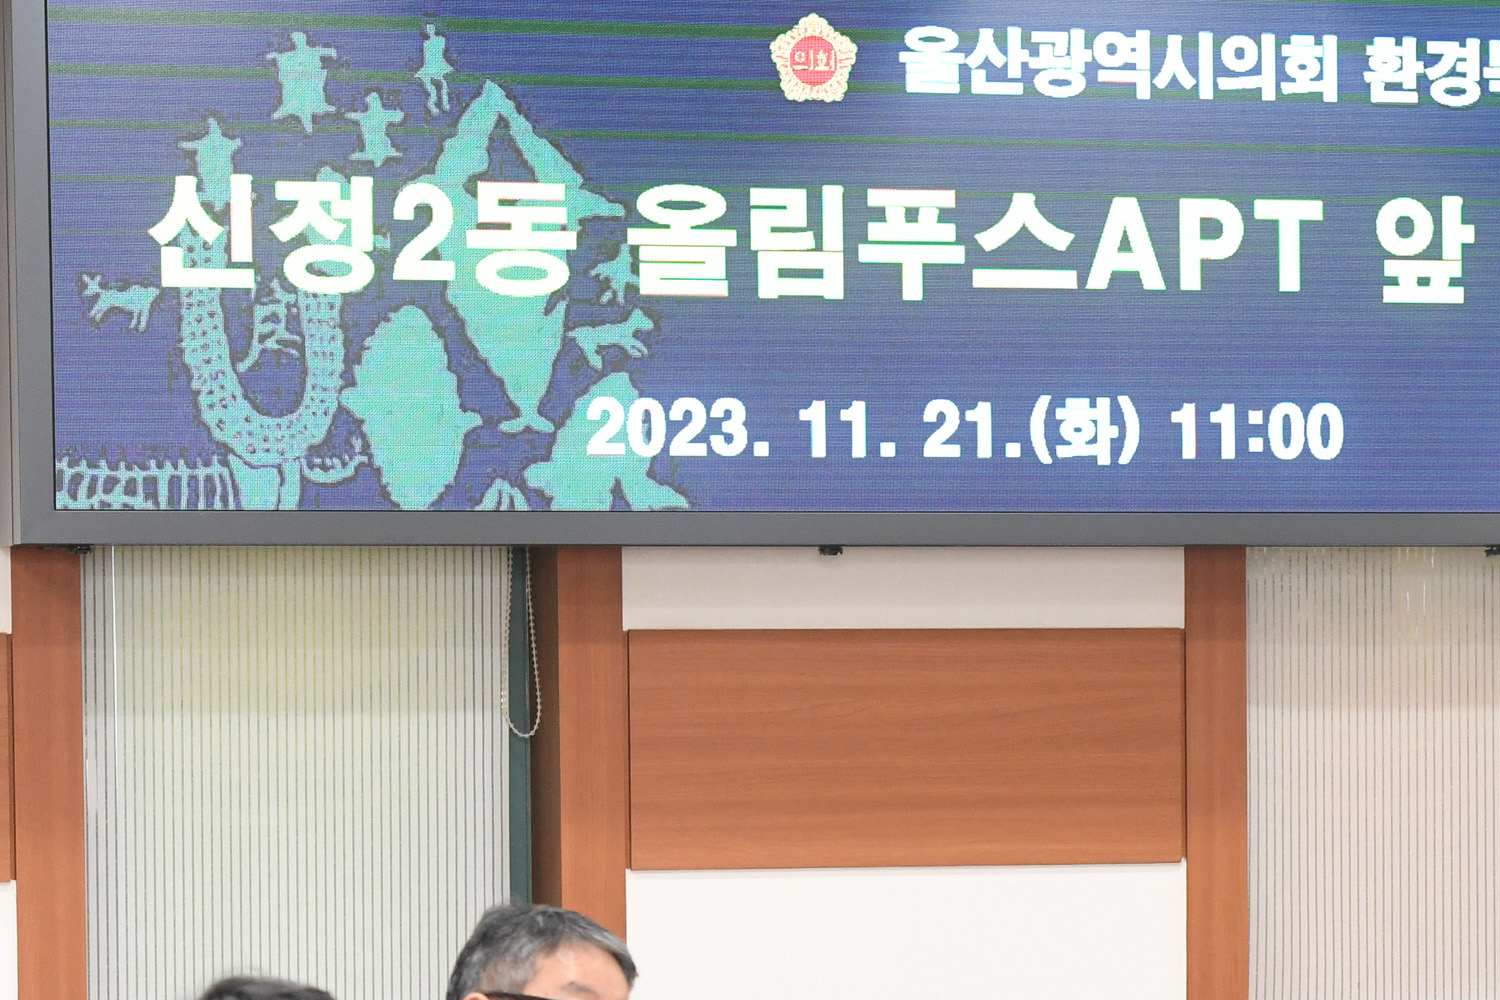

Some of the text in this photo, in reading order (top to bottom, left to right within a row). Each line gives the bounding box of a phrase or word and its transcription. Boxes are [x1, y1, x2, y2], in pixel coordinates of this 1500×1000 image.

[792, 49, 836, 72] 의회
[899, 26, 1338, 103] 울산광역시의회
[148, 174, 577, 297] 신정2동
[627, 184, 1323, 301] 올림푸스APT
[1376, 195, 1475, 304] 앞
[586, 395, 1344, 465] 2023. 11. 21.(화) 11:00
